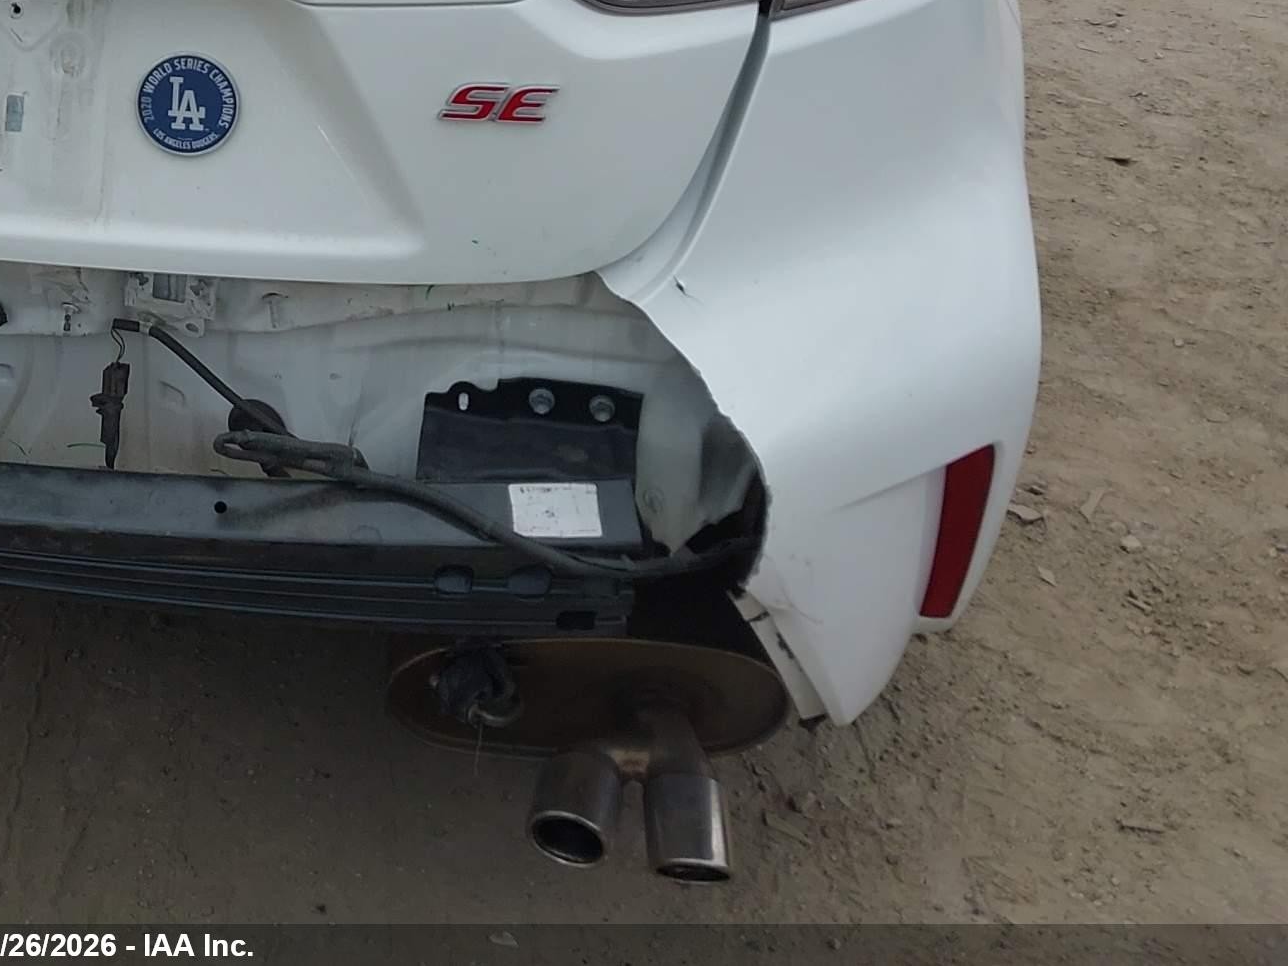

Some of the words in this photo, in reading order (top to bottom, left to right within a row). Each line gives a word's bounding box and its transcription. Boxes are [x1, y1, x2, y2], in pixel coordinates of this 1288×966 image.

[142, 62, 173, 94] WORLD
[174, 57, 210, 75] SERIES
[140, 95, 154, 123] 2020
[167, 76, 206, 131] LA
[208, 68, 234, 129] CHAMPIONS
[438, 83, 560, 123] SE
[164, 136, 192, 149] ANGELES
